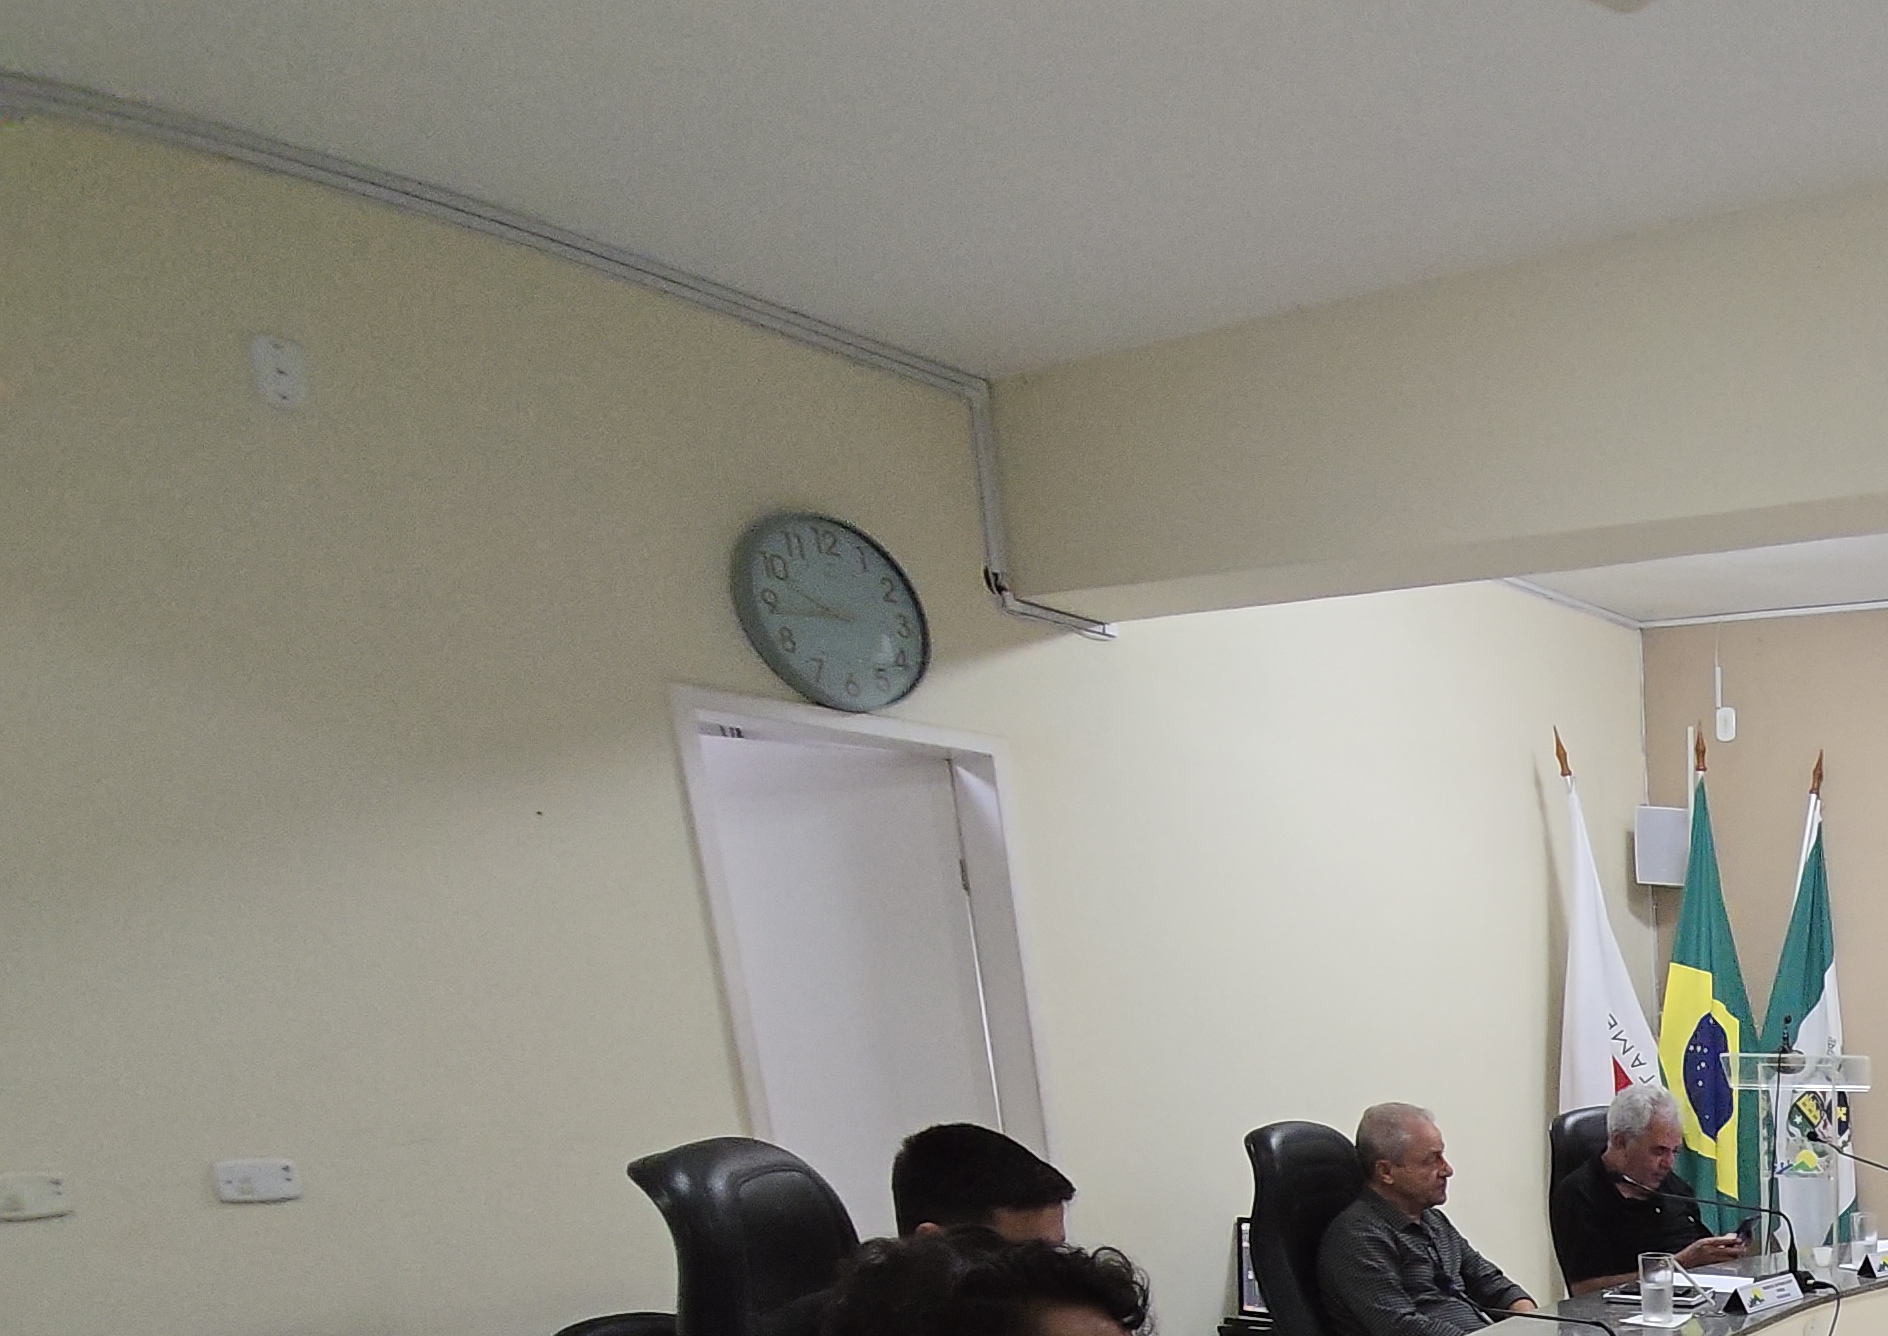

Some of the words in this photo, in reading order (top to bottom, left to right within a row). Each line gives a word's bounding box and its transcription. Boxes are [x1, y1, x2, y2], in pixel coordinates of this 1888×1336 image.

[783, 530, 806, 560] 11
[810, 526, 841, 557] 12
[760, 550, 789, 581] 10
[856, 546, 868, 571] 1
[761, 587, 778, 614] 9
[880, 576, 898, 603] 2
[779, 626, 797, 653] 8
[897, 613, 911, 639] 3
[810, 655, 825, 682] 7
[846, 674, 860, 697] 6
